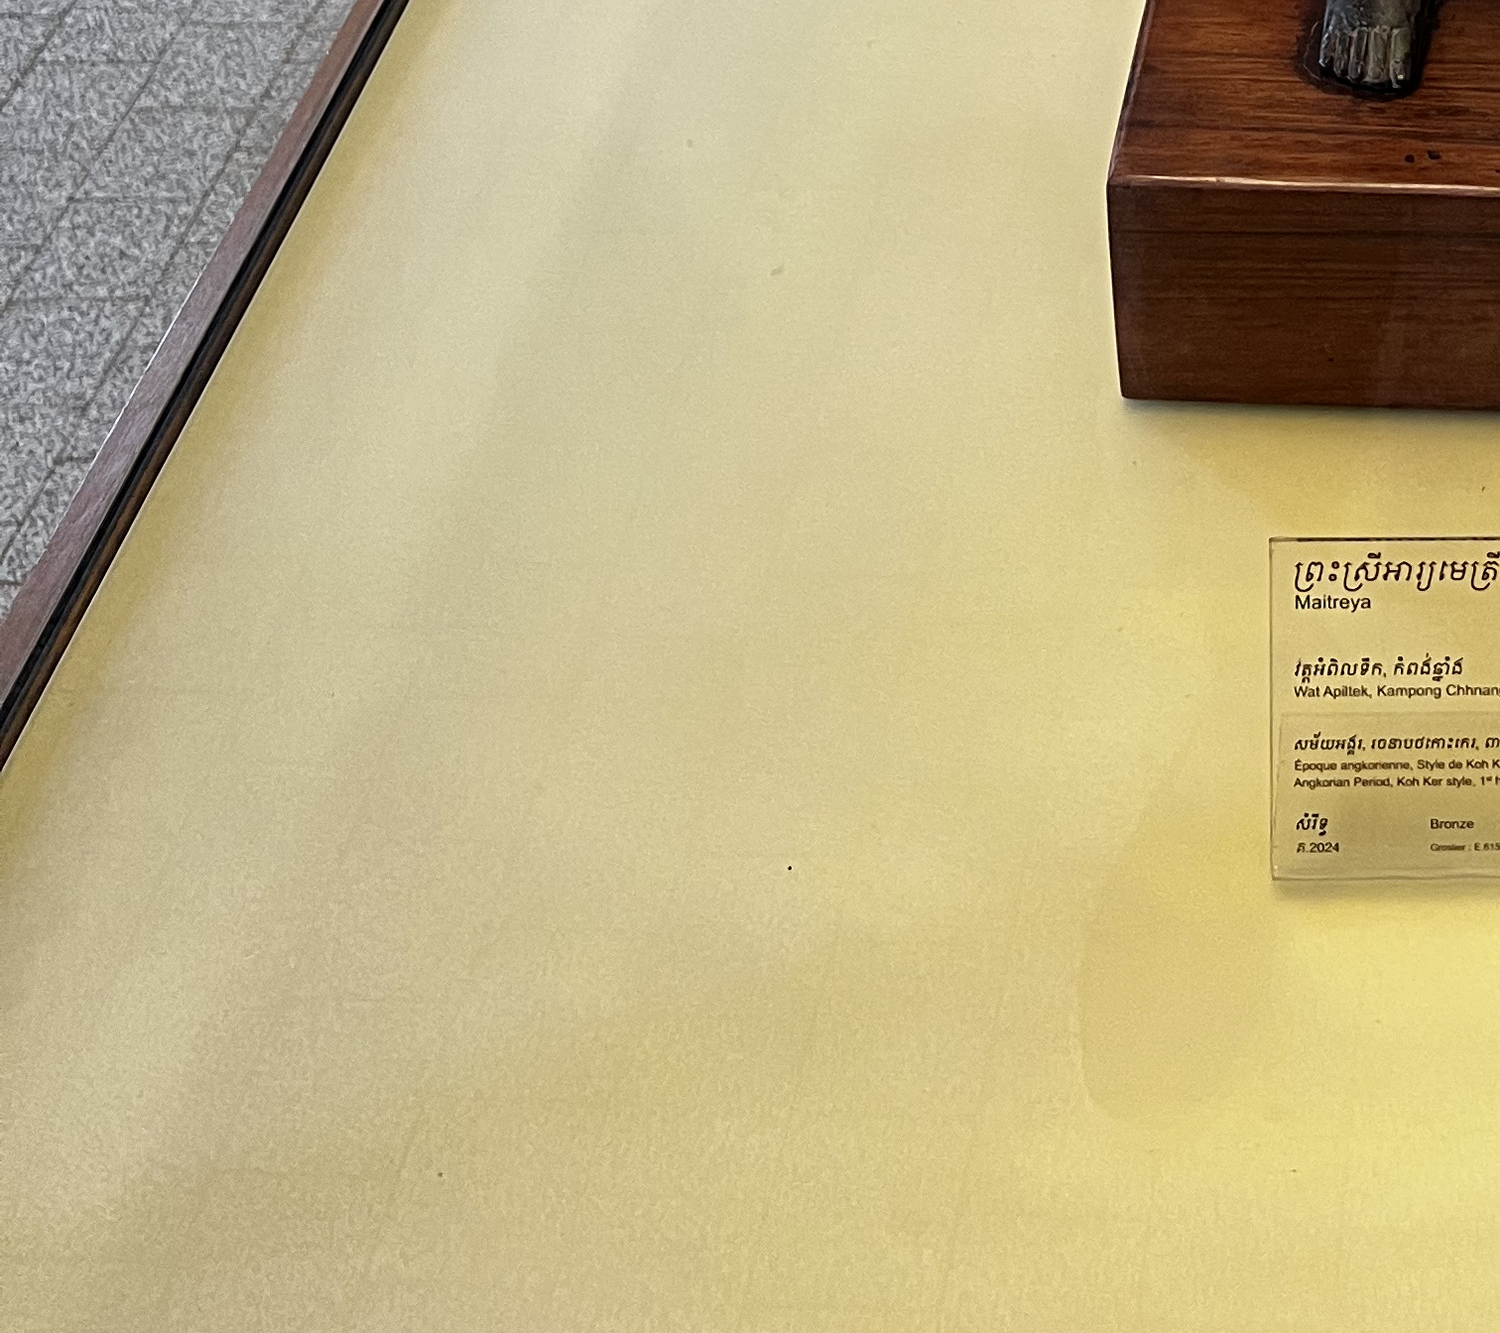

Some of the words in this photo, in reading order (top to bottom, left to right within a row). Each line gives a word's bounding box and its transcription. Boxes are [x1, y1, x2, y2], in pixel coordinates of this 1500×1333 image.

[1295, 595, 1371, 613] Maitreya
[1393, 652, 1464, 682] កំពង់ឆ្នាំង
[1294, 686, 1320, 697] Wat
[1377, 685, 1442, 699] Kampong
[1294, 759, 1337, 773] Époque
[1341, 760, 1414, 773] angkorienne,
[1417, 759, 1445, 771] Style
[1448, 760, 1463, 770] de
[1466, 759, 1488, 769] Koh
[1294, 777, 1350, 790] Angkorian
[1354, 777, 1394, 788] Period,
[1397, 776, 1420, 787] Koh
[1423, 776, 1443, 786] Ker
[1430, 818, 1475, 829] Bronze
